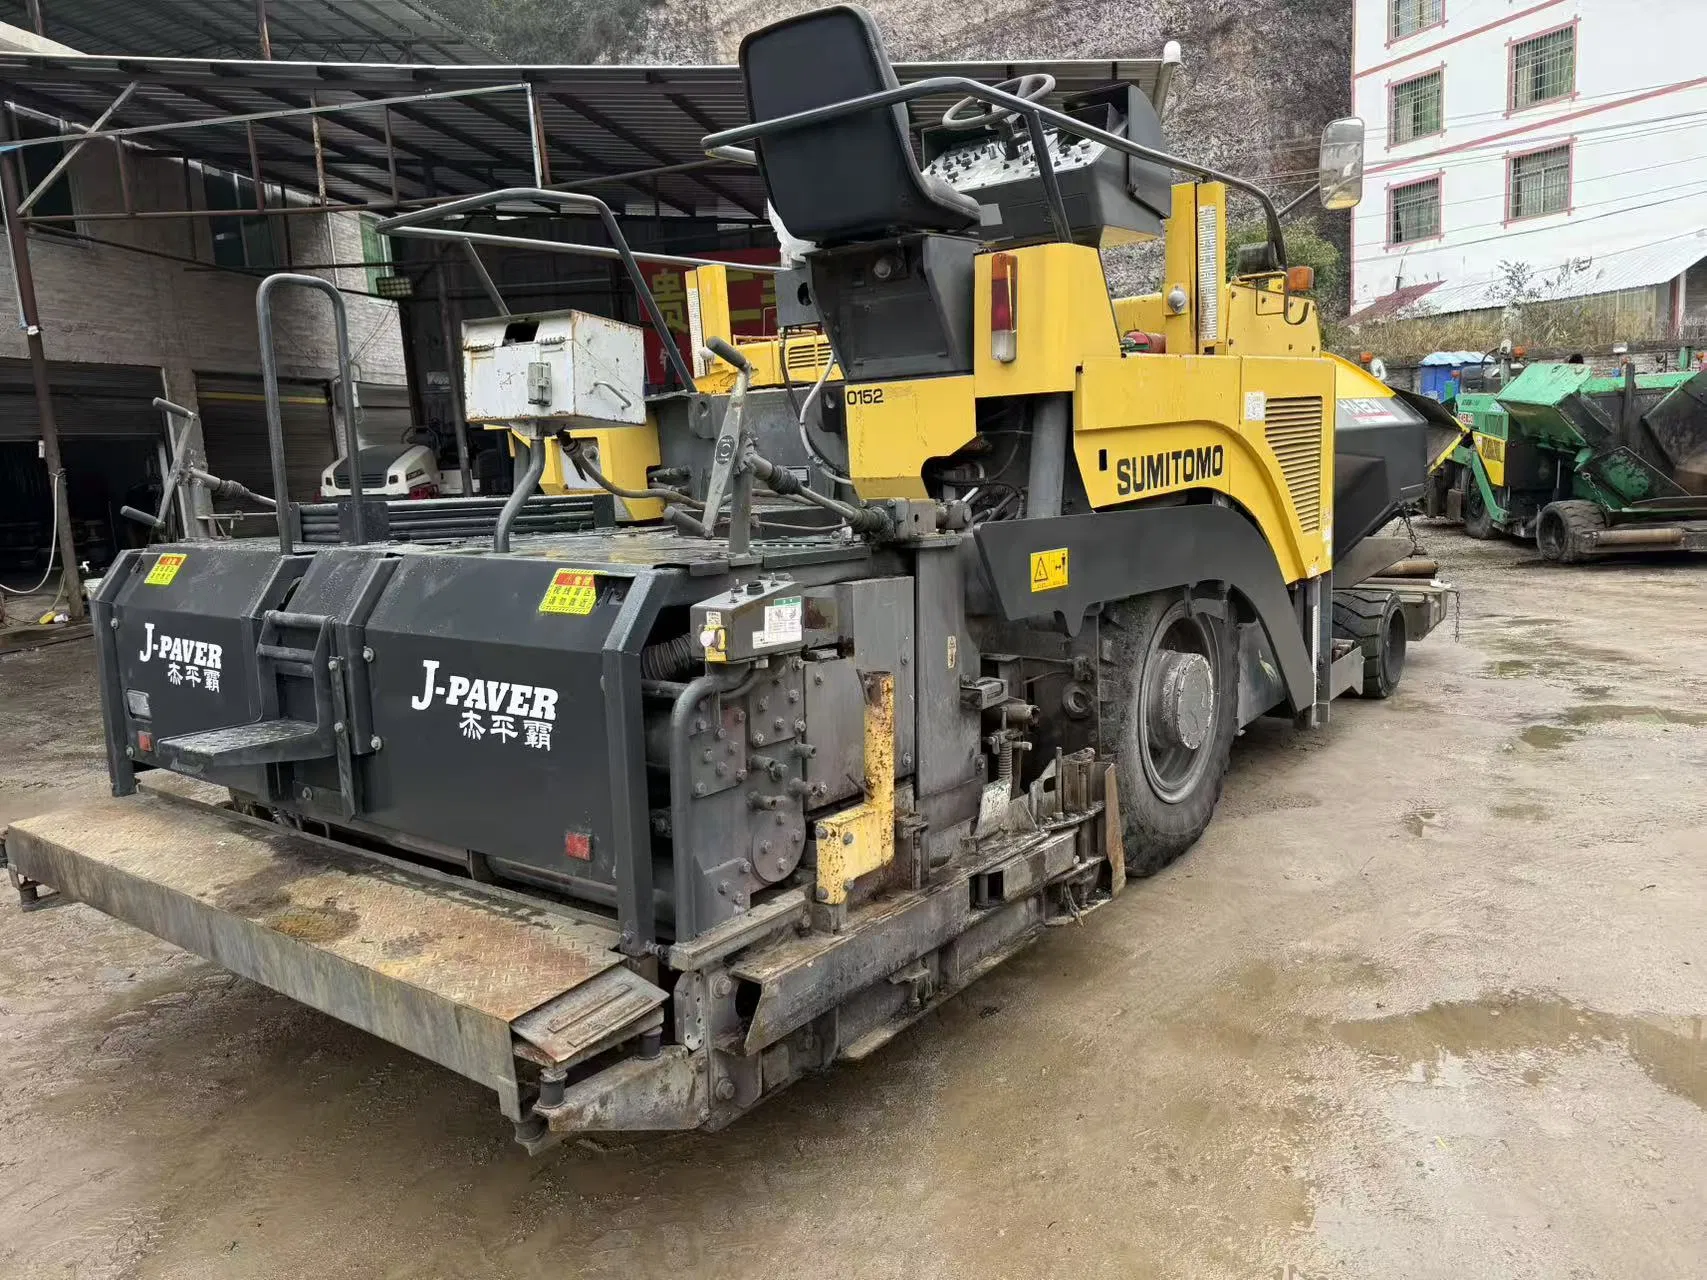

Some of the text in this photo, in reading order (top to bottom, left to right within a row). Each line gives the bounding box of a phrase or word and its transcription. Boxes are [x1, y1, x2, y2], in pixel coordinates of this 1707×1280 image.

[847, 388, 884, 405] 0152
[1117, 444, 1224, 496] SUMITOMO
[139, 622, 223, 670] J-PAVER
[167, 661, 221, 693] 杰平霸
[411, 659, 559, 721] J-PAVER
[458, 709, 553, 752] 杰平霸
